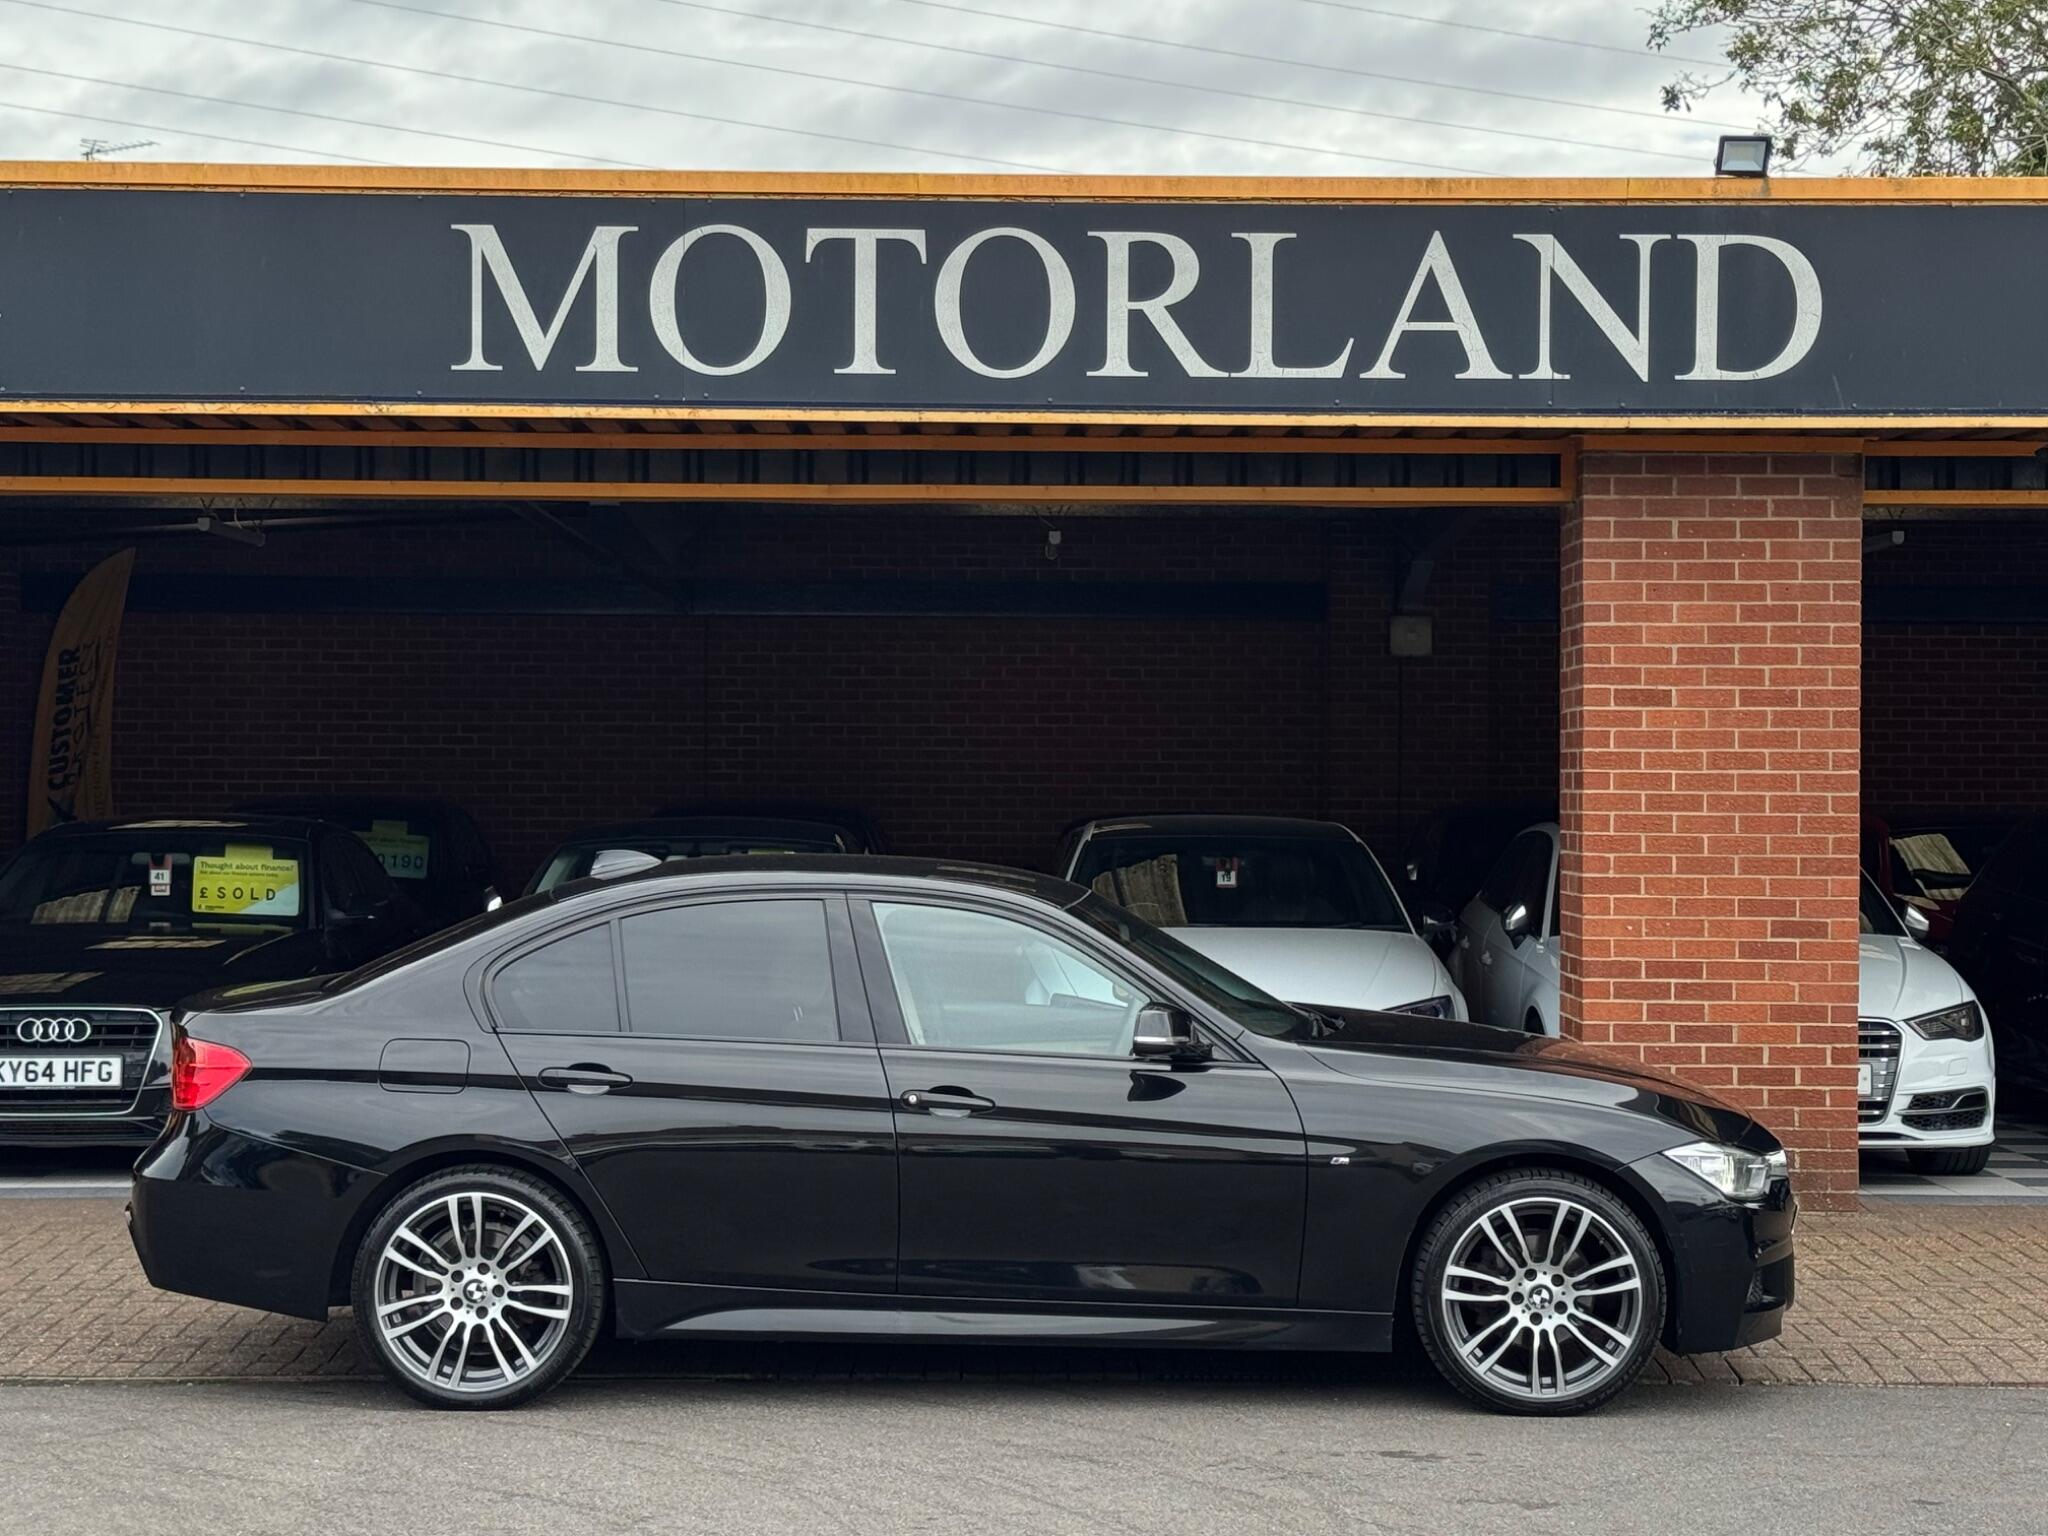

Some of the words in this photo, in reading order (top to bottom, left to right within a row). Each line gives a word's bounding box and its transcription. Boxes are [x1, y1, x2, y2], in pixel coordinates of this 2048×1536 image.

[451, 225, 1822, 382] MOTORLAND
[48, 647, 80, 790] CUSTOMER
[200, 861, 233, 870] Thought
[236, 862, 258, 871] about
[154, 872, 164, 881] 41
[199, 886, 208, 899] £
[216, 886, 276, 901] SOLD
[63, 1060, 113, 1083] HFG
